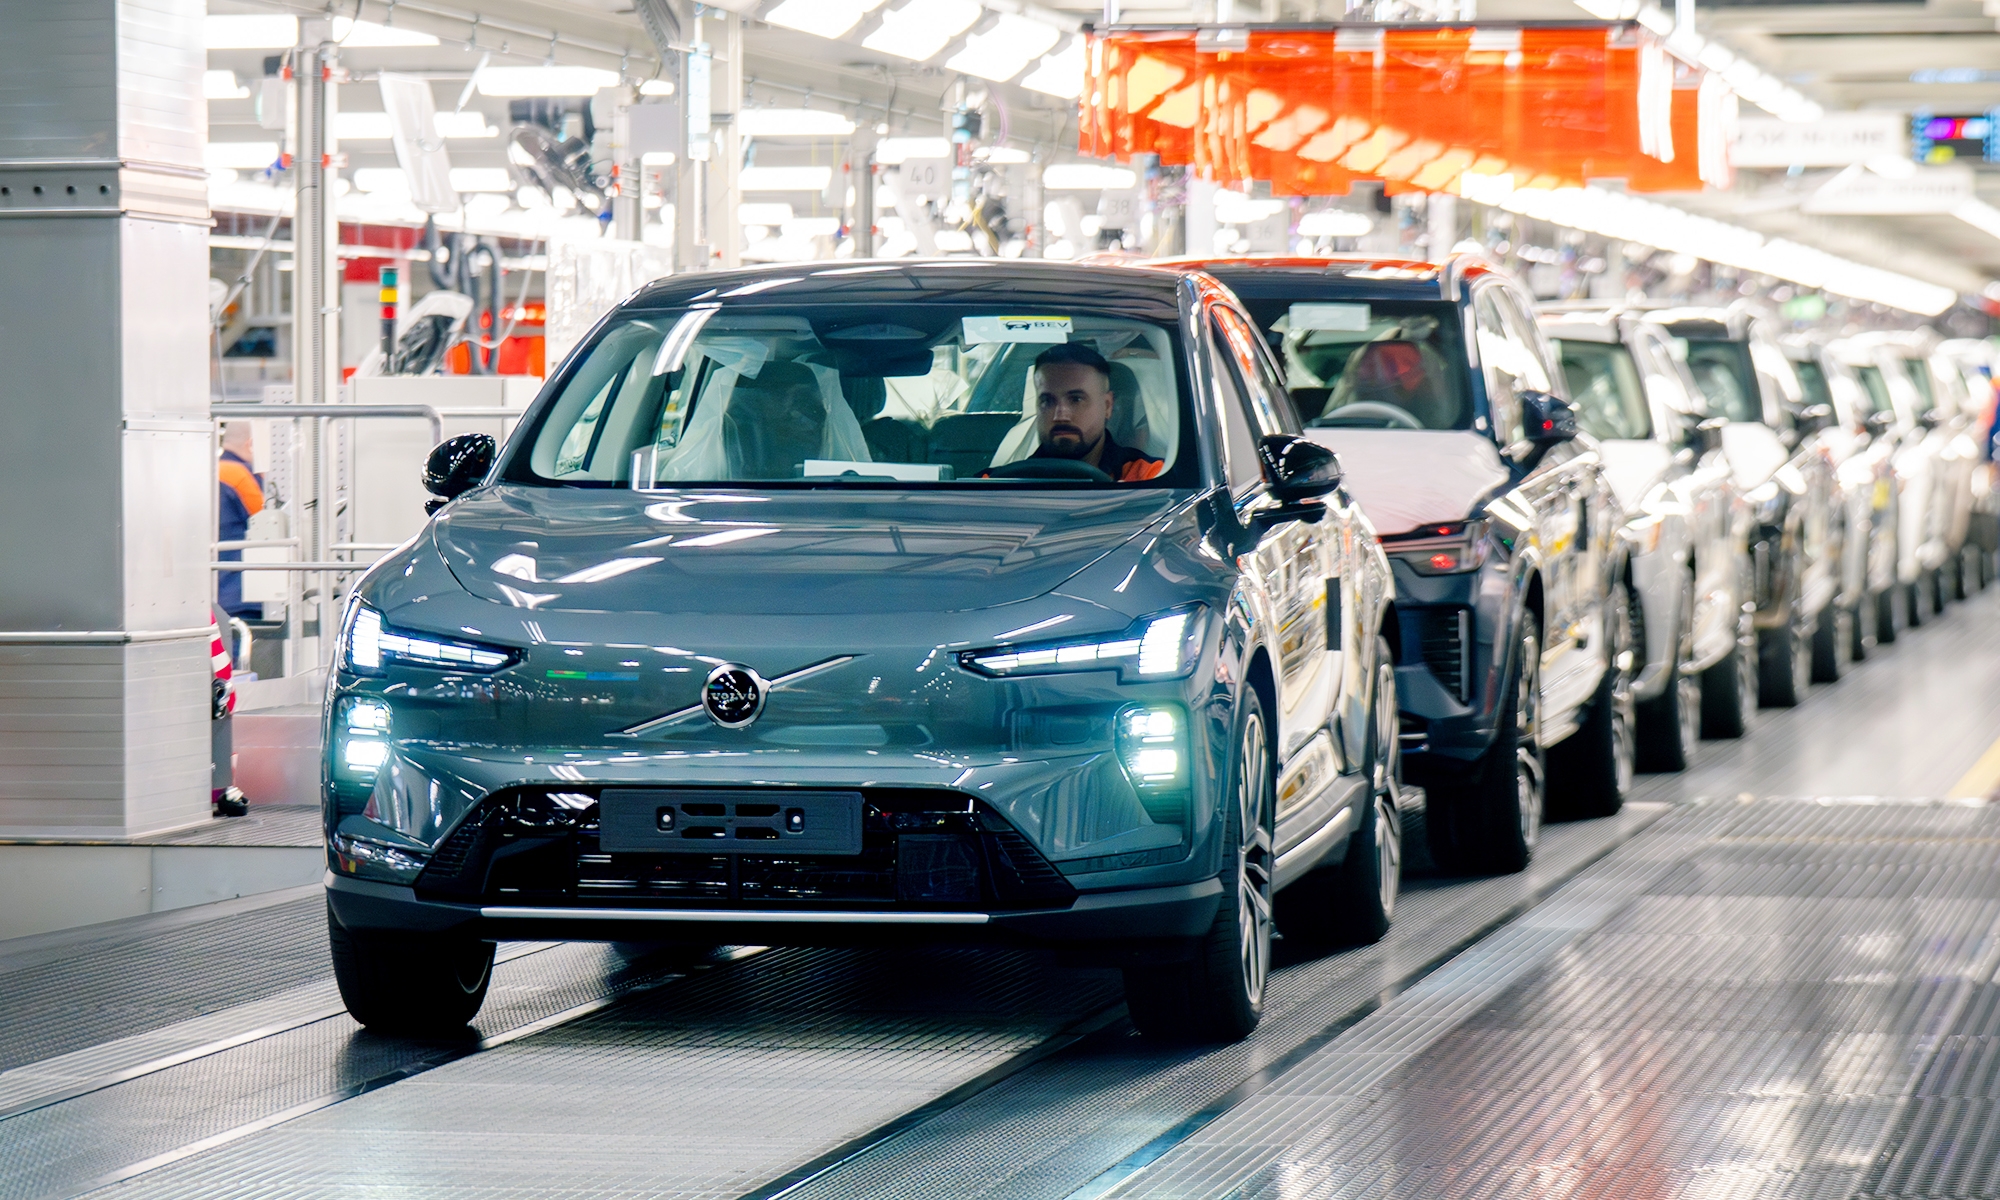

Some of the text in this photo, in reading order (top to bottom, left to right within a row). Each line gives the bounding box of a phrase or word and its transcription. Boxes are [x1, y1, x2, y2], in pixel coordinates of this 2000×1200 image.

[910, 166, 935, 186] 40
[1109, 199, 1130, 216] 38
[709, 692, 757, 701] VOLVO
